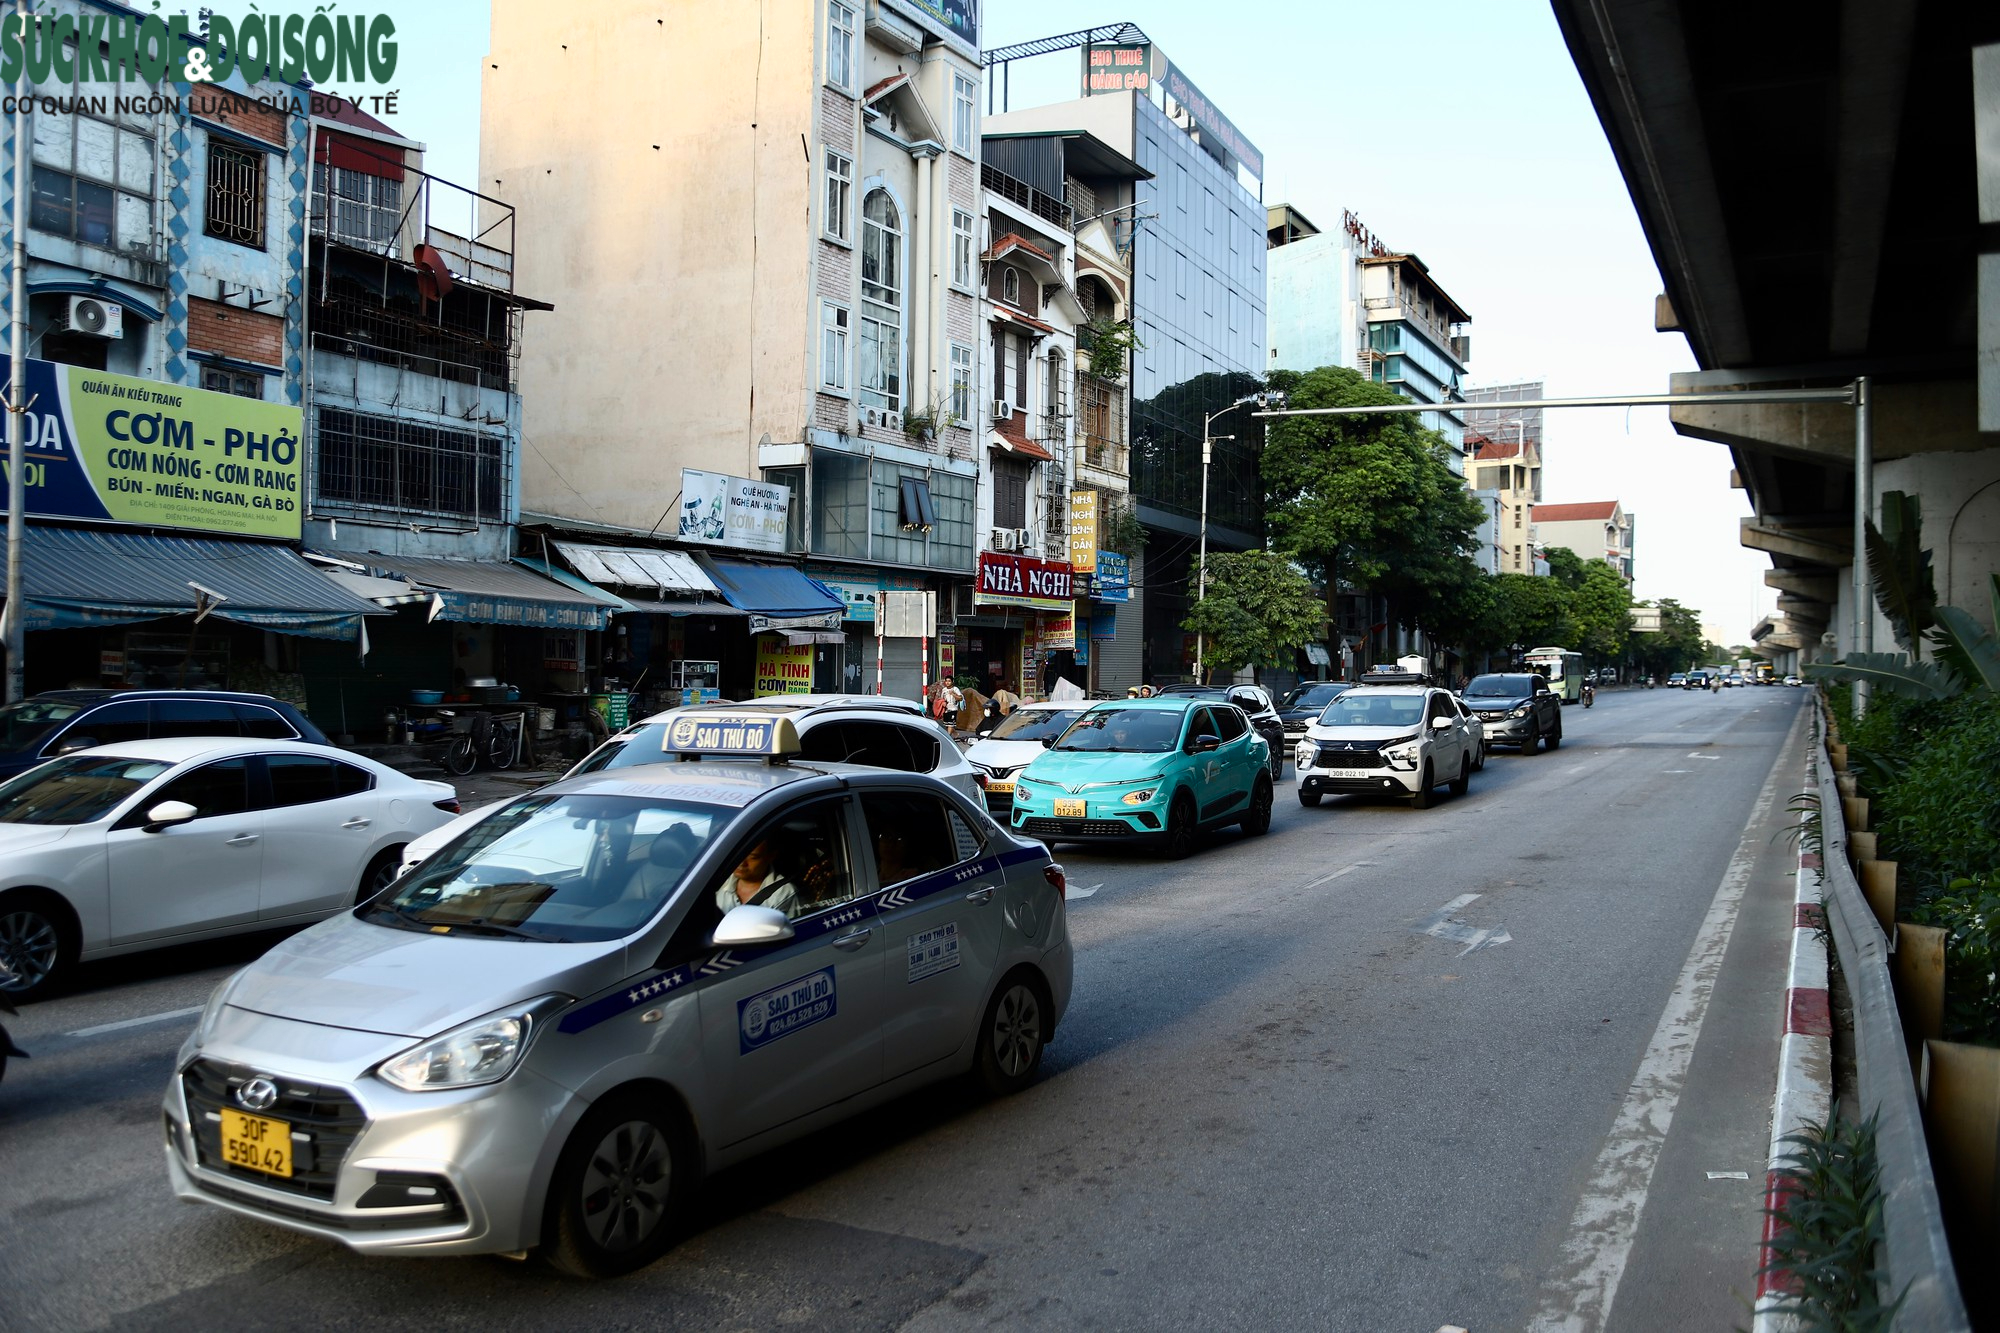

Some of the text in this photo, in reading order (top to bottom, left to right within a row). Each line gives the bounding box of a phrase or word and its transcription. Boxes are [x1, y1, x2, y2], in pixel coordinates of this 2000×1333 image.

[1090, 46, 1143, 66] CHO THUÊ
[1124, 69, 1148, 90] CÁO
[82, 380, 110, 396] QUÁN
[111, 384, 126, 398] ĂN
[152, 392, 182, 408] TRANG
[106, 409, 194, 451] CƠM
[225, 428, 299, 466] PHỞ
[107, 448, 148, 473] CƠM
[152, 452, 201, 480] NÓNG
[215, 463, 250, 486] CƠM
[254, 468, 296, 492] RANG
[108, 476, 142, 494] BÚN
[155, 482, 199, 501] MIẾN:
[202, 489, 249, 509] NGAN,
[252, 494, 272, 510] GÀ
[275, 496, 295, 512] BÒ
[742, 486, 780, 500] QUÊ HƯƠNG
[1072, 492, 1093, 506] NHÀ
[731, 497, 750, 509] NGHỆ
[750, 500, 760, 509] AN
[763, 500, 773, 511] HÀ
[1071, 506, 1095, 520] NGHỈ
[728, 511, 756, 530] CƠM
[763, 516, 786, 535] PHỞ
[1073, 538, 1093, 550] DÂN
[1076, 554, 1088, 564] 17
[983, 560, 1071, 597] NHÀ NGHỈ
[468, 601, 494, 618] CƠM
[760, 660, 809, 678] HÀ TĨNH
[758, 678, 787, 692] CƠM
[696, 723, 764, 749] SAO THỦ ĐÔ
[1057, 808, 1082, 816] 012.89
[768, 975, 828, 1017] SAO THỦ ĐÔ
[240, 1116, 269, 1142] 30F
[229, 1139, 284, 1172] 590.42
